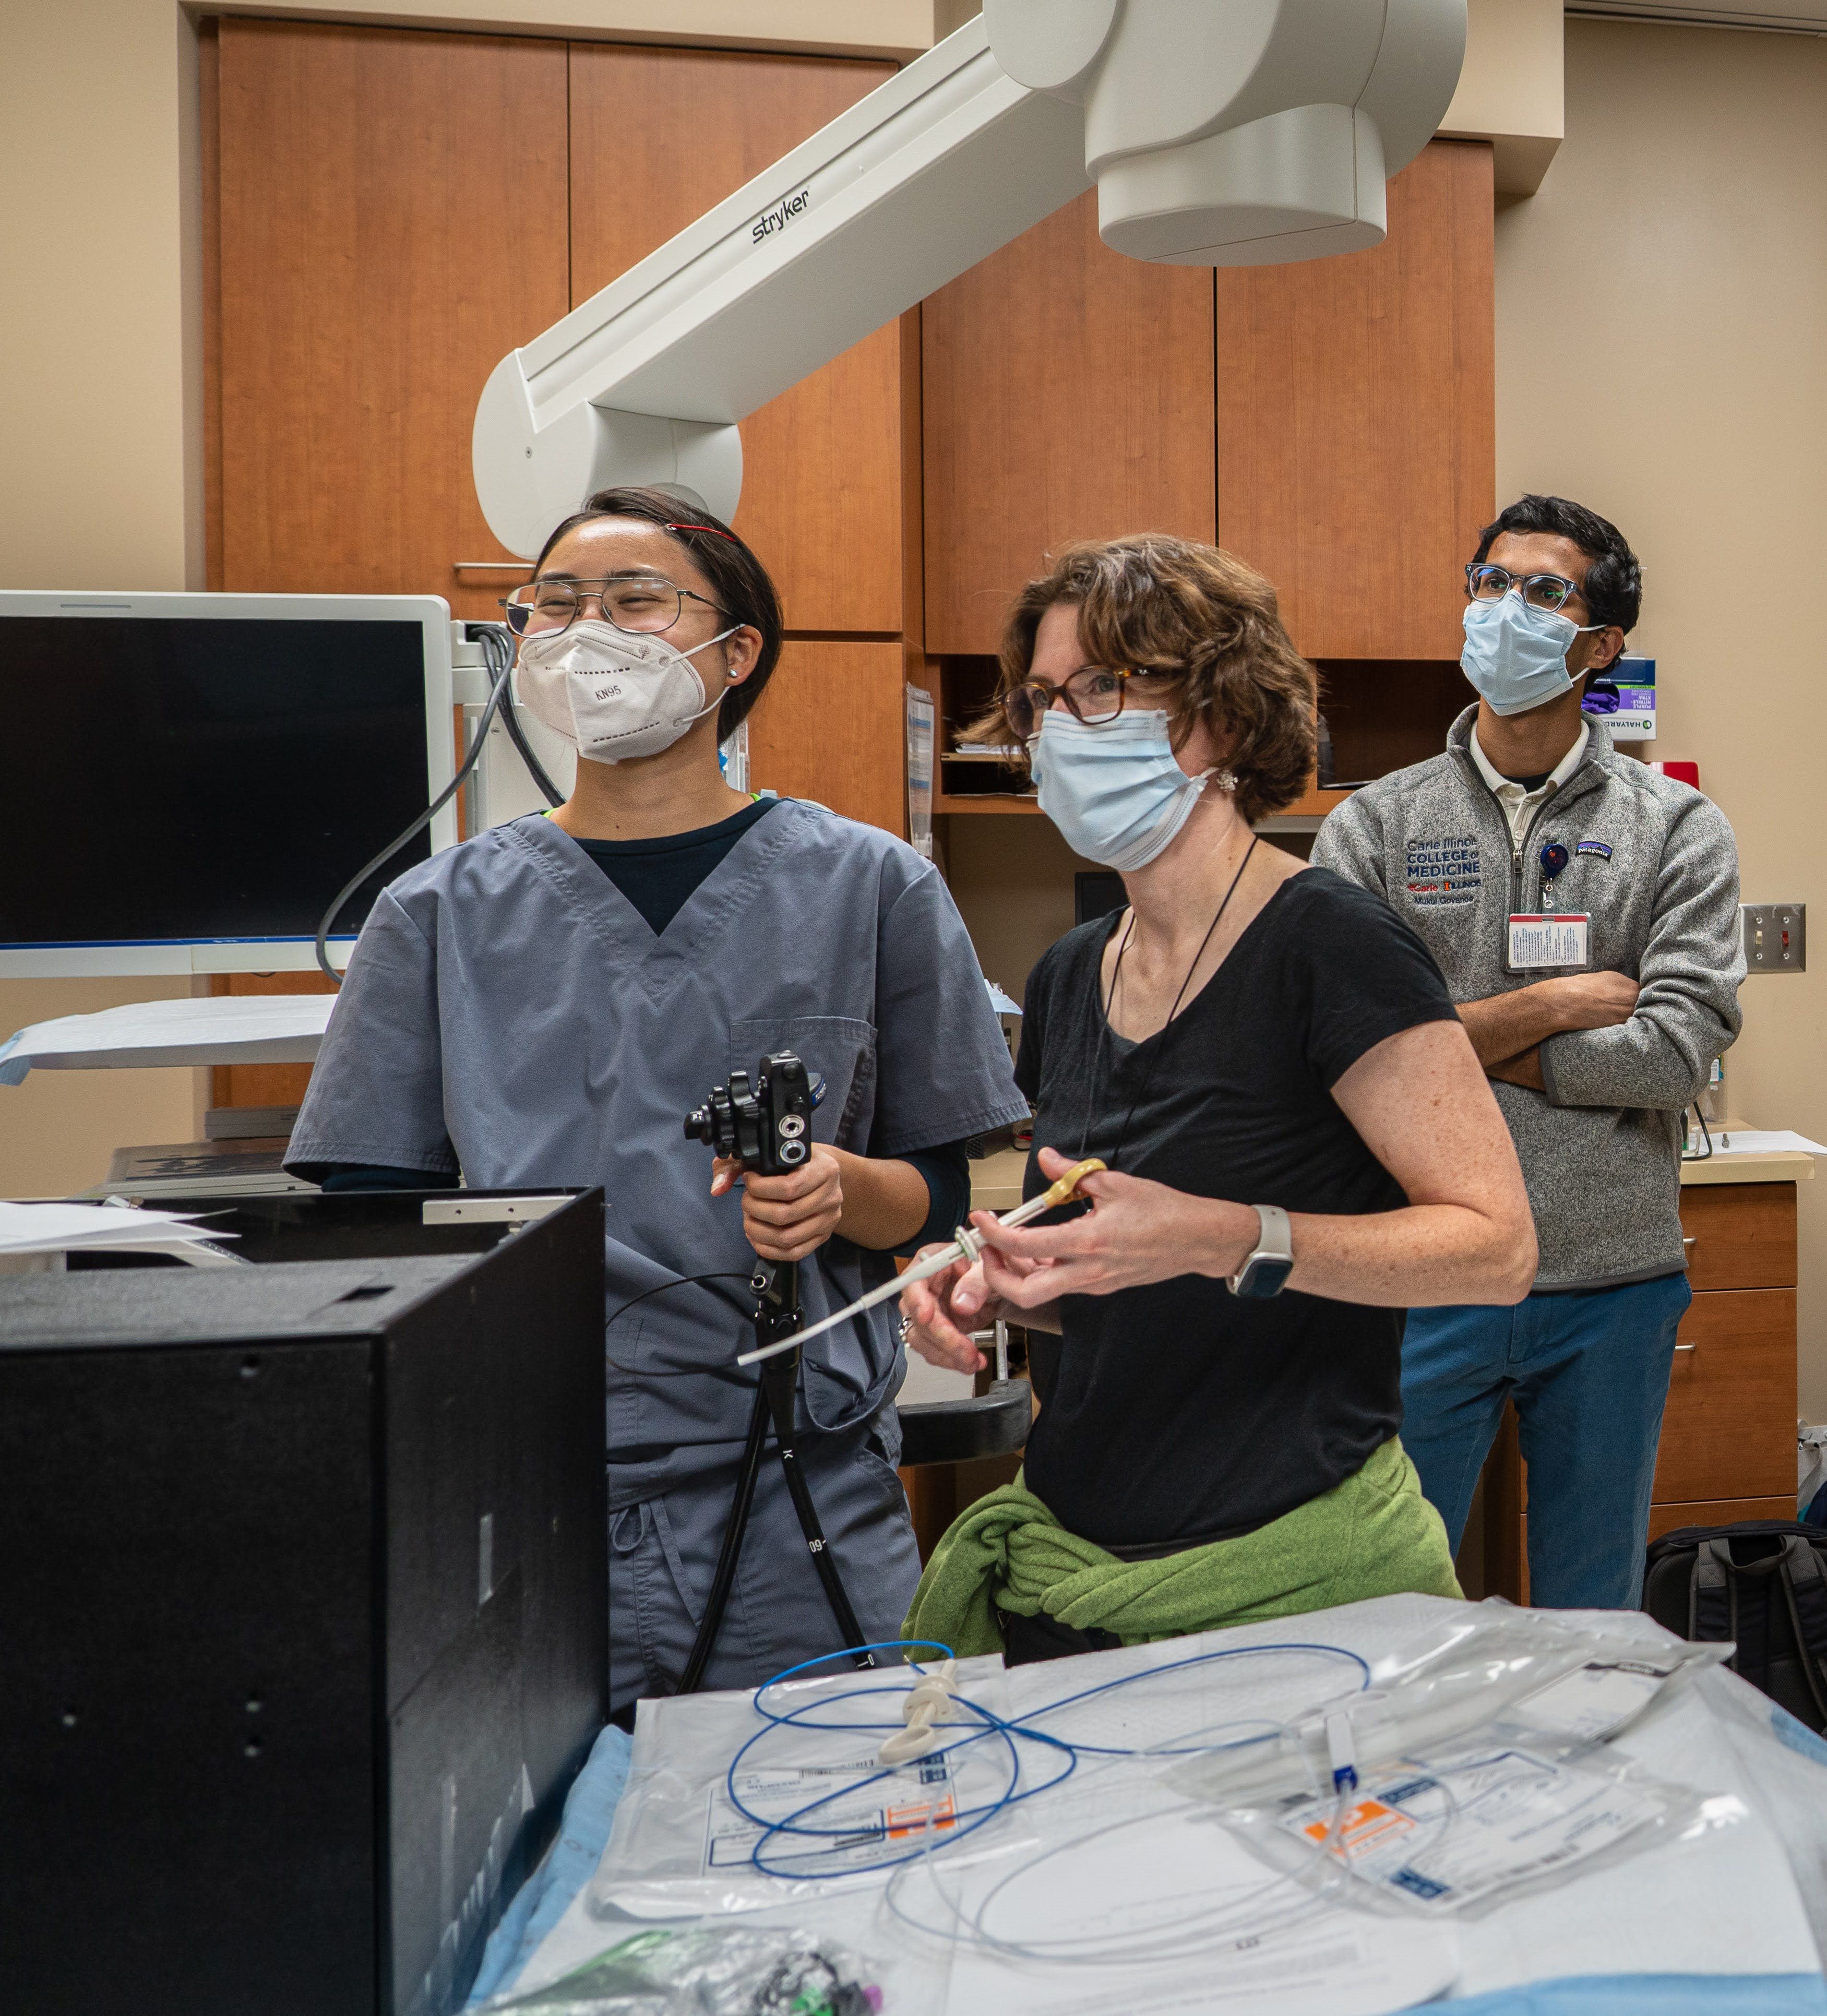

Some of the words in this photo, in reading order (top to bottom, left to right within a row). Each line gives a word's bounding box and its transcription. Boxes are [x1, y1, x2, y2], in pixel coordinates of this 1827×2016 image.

[753, 190, 808, 244] stryker
[595, 685, 622, 701] KN95
[1408, 840, 1440, 851] Carle
[1578, 848, 1608, 857] patagonia
[1407, 850, 1468, 864] COLLEGE
[1407, 862, 1480, 877] MEDICINE
[1415, 883, 1438, 892] Carle
